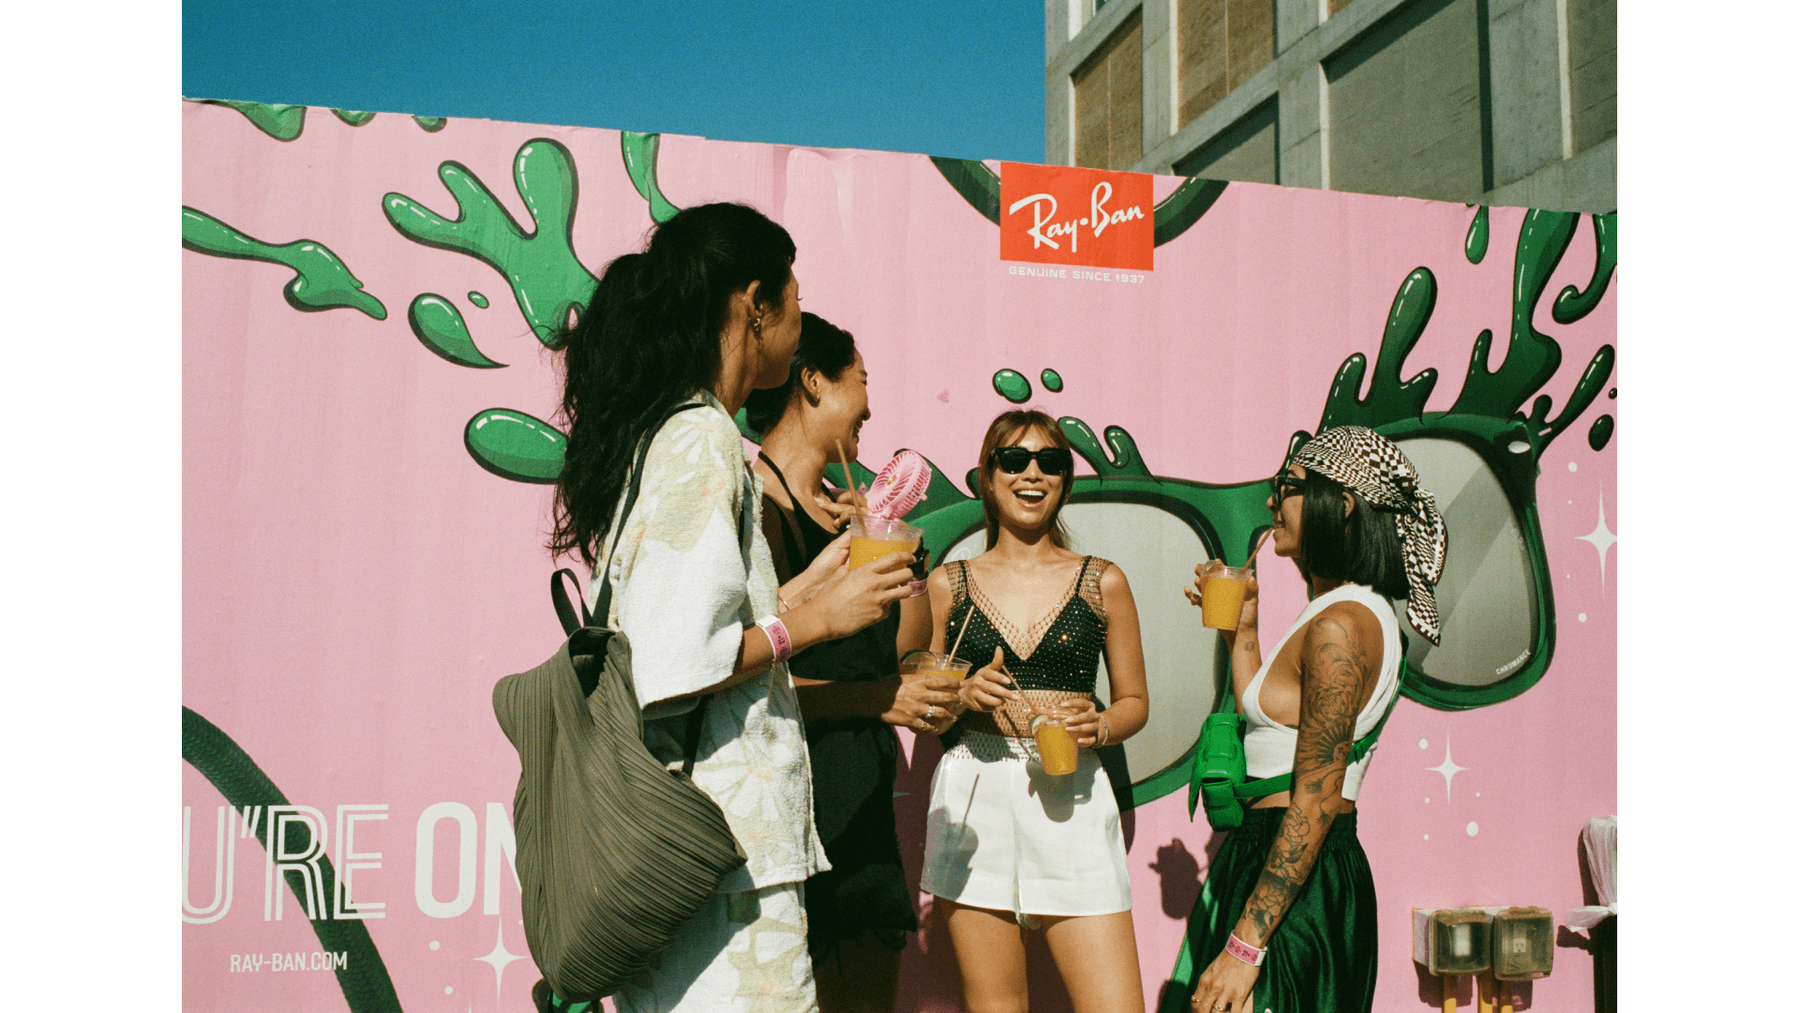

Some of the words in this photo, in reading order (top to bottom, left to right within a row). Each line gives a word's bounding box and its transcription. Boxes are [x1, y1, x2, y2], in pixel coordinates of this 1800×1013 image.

[1009, 266, 1067, 278] GENUINE
[1072, 270, 1111, 281] SINCE
[1115, 274, 1145, 284] 1937
[230, 951, 348, 973] RAY-BAN.COM
